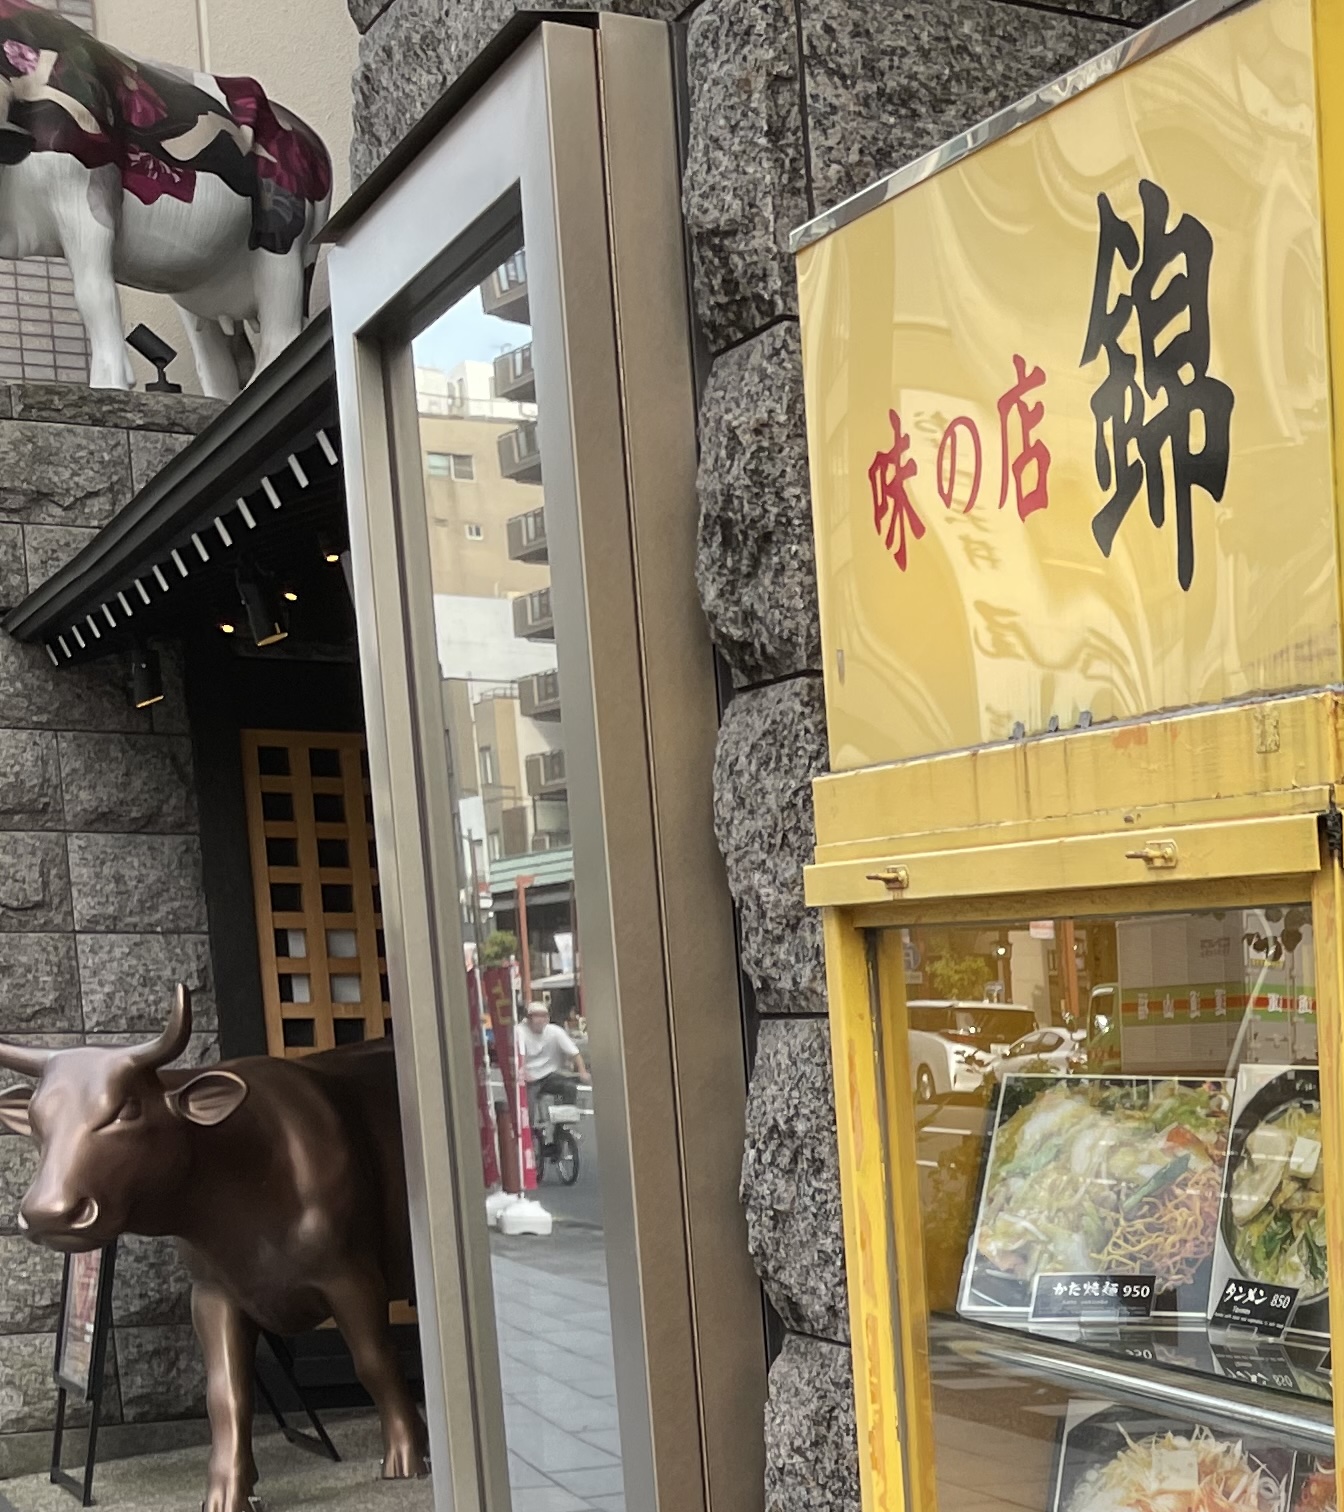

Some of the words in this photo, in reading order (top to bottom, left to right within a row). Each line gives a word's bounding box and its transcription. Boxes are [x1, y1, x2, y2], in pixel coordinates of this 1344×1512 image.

[867, 353, 1051, 573] 味の店
[1080, 178, 1236, 593] 錦
[1123, 1285, 1150, 1298] 950
[1223, 1282, 1268, 1305] タンメン
[1270, 1293, 1291, 1309] 850
